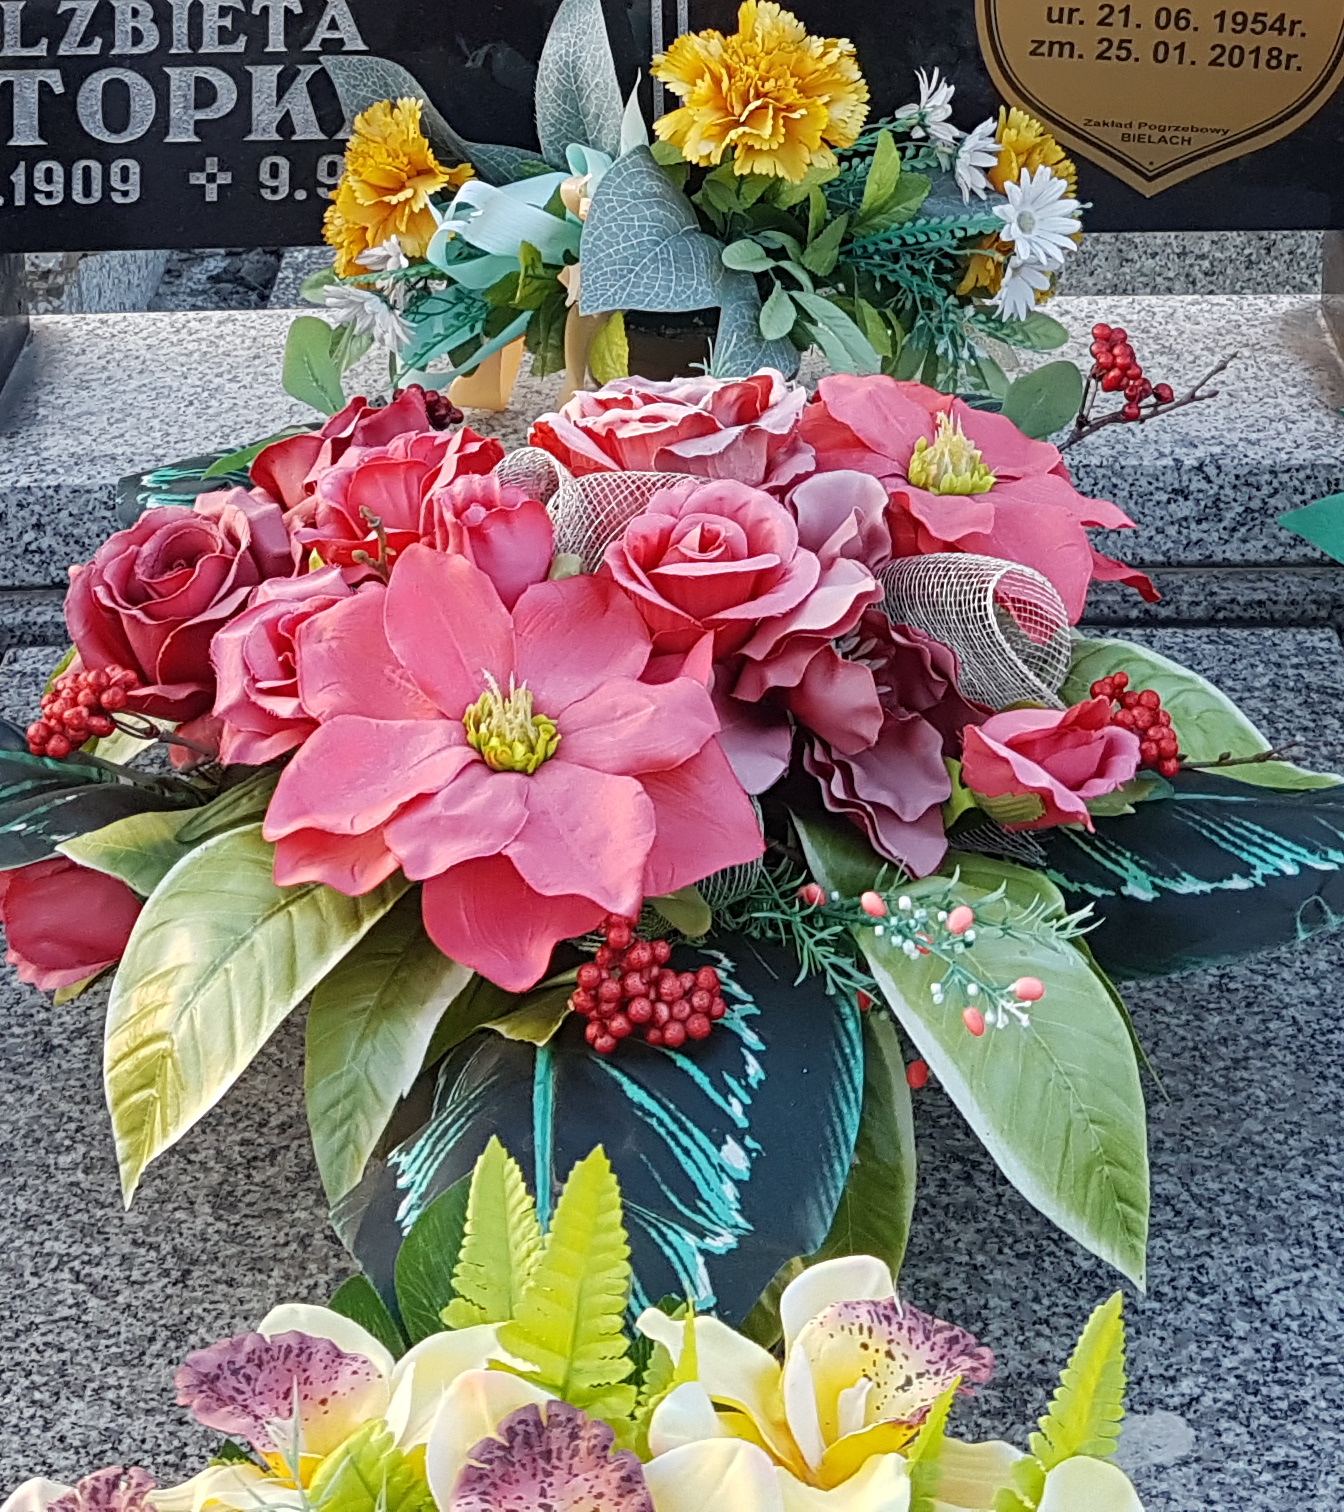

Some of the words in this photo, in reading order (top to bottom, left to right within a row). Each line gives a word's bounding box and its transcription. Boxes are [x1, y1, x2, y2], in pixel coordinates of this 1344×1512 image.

[1046, 5, 1086, 26] ur.
[1096, 3, 1142, 29] 21.
[1154, 6, 1199, 33] 06.
[1213, 9, 1308, 38] 1954r.
[1029, 38, 1084, 60] zm.
[1095, 37, 1141, 63] 25.
[1152, 40, 1197, 66] 01.
[1207, 43, 1303, 72] 2018r.
[1083, 117, 1135, 131] Zakład
[1138, 120, 1231, 137] Pogrzebowy
[1120, 132, 1193, 147] BIELACH
[259, 154, 343, 203] 9.9
